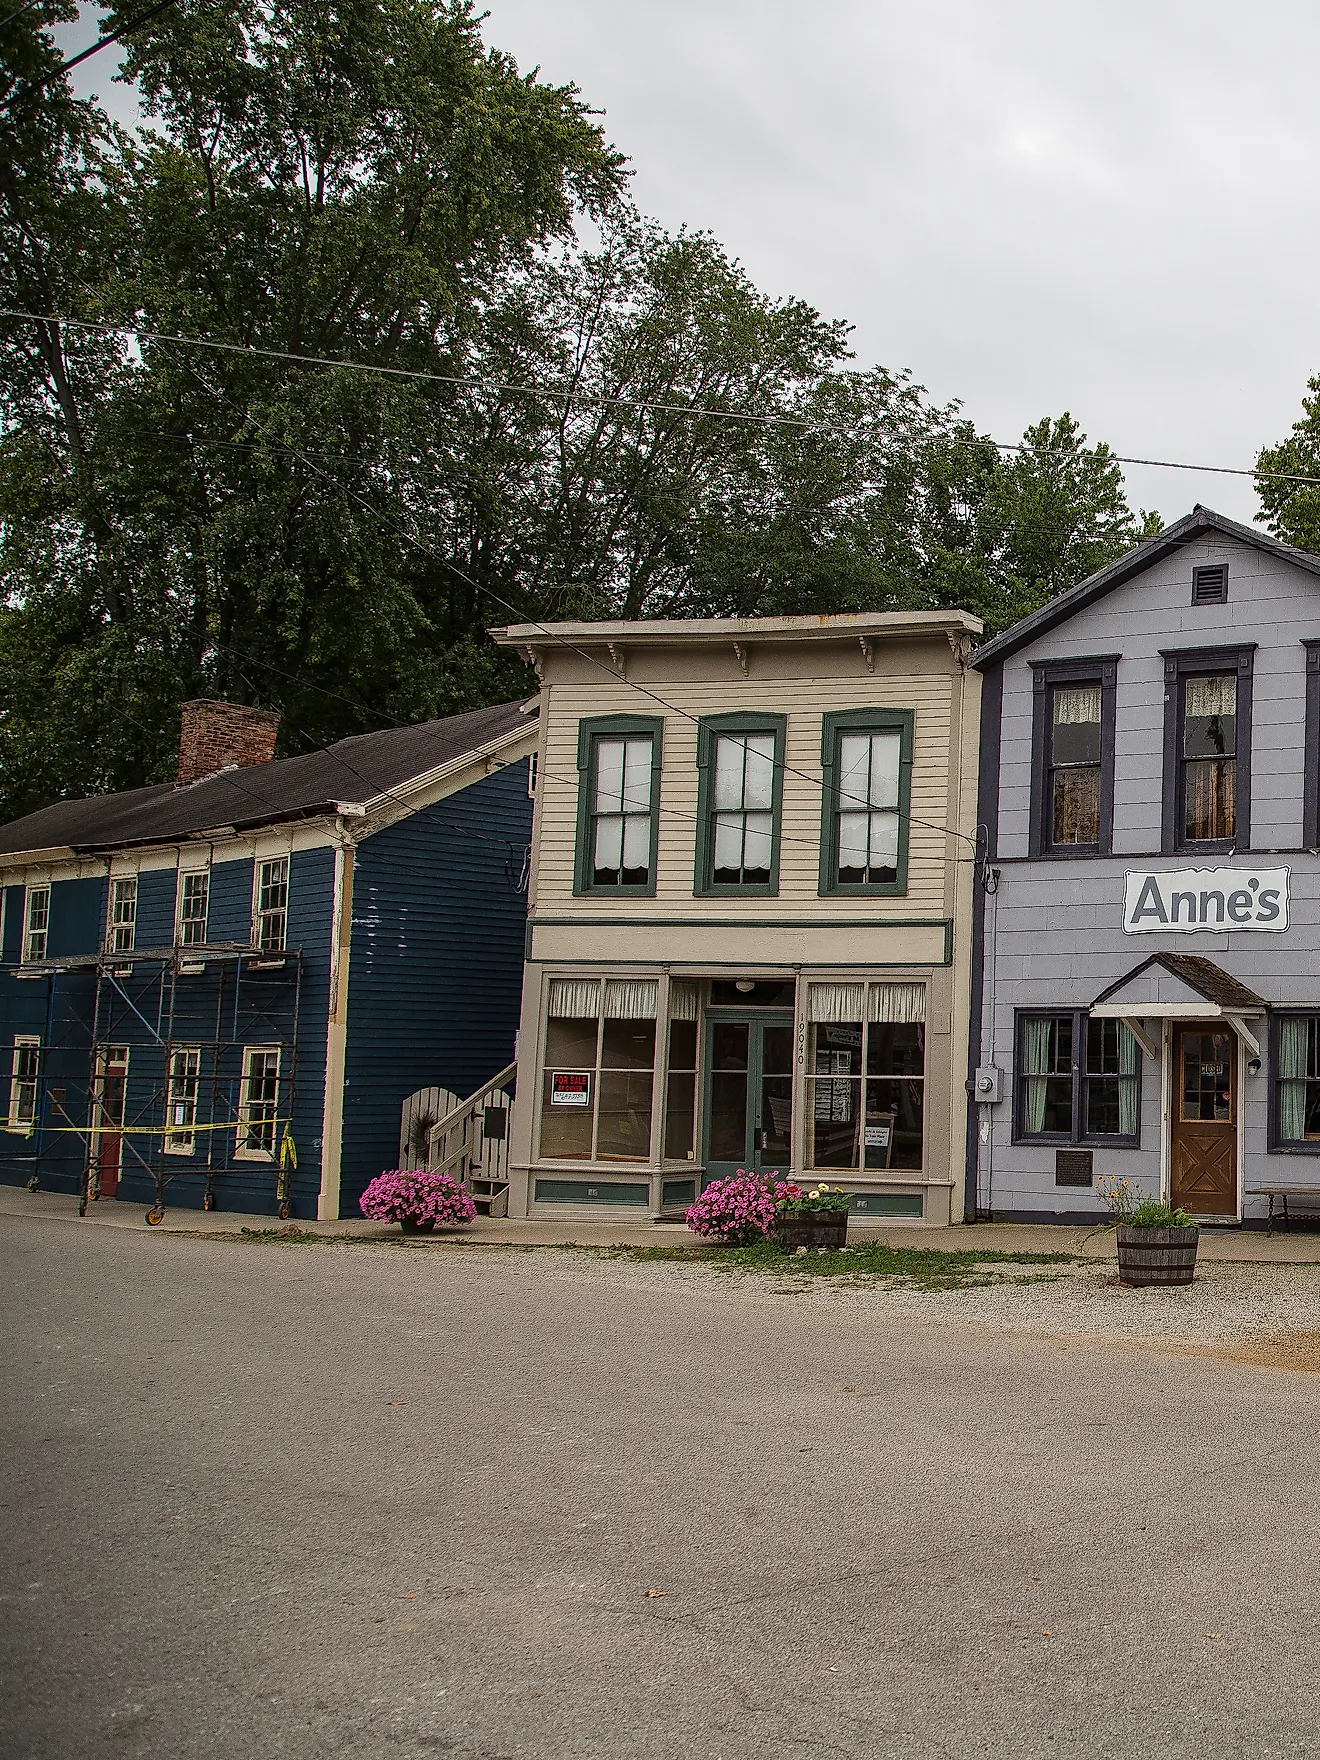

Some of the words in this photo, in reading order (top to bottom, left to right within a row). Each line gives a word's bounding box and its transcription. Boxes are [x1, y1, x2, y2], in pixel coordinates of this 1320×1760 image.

[1130, 876, 1280, 923] Anne's
[555, 1075, 568, 1085] FOR
[569, 1075, 587, 1085] SALE
[565, 1084, 583, 1092] OWNER
